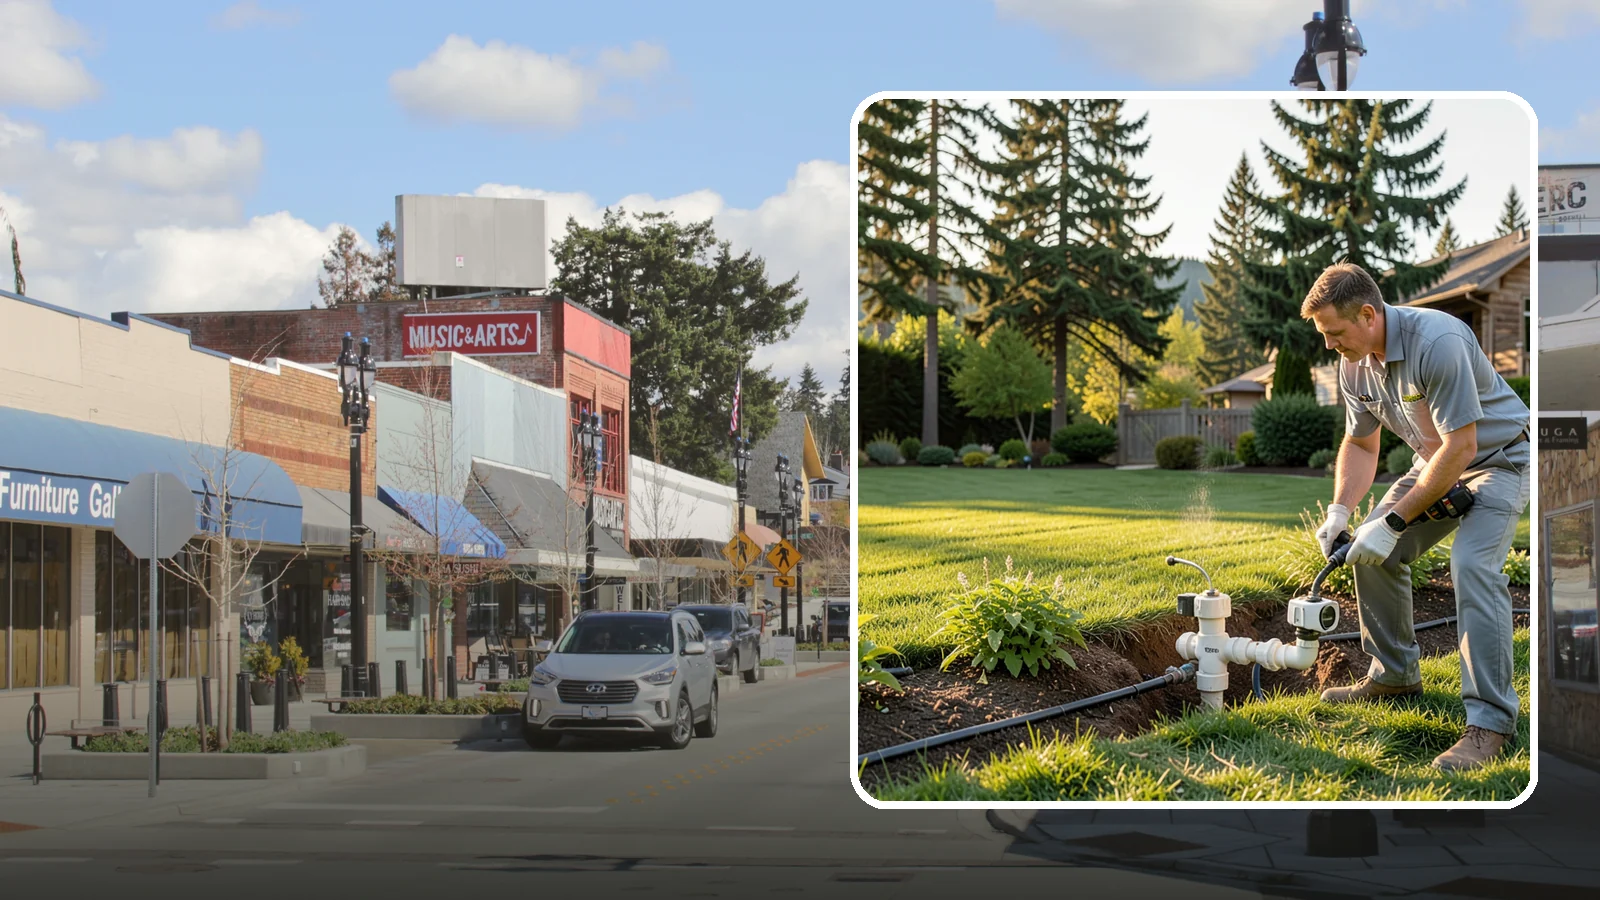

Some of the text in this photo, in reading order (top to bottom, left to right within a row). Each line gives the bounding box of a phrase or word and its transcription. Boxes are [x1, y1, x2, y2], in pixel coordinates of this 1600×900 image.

[408, 322, 520, 349] MUSIC&ARTS
[1540, 427, 1578, 437] UGA
[0, 471, 79, 516] Furniture
